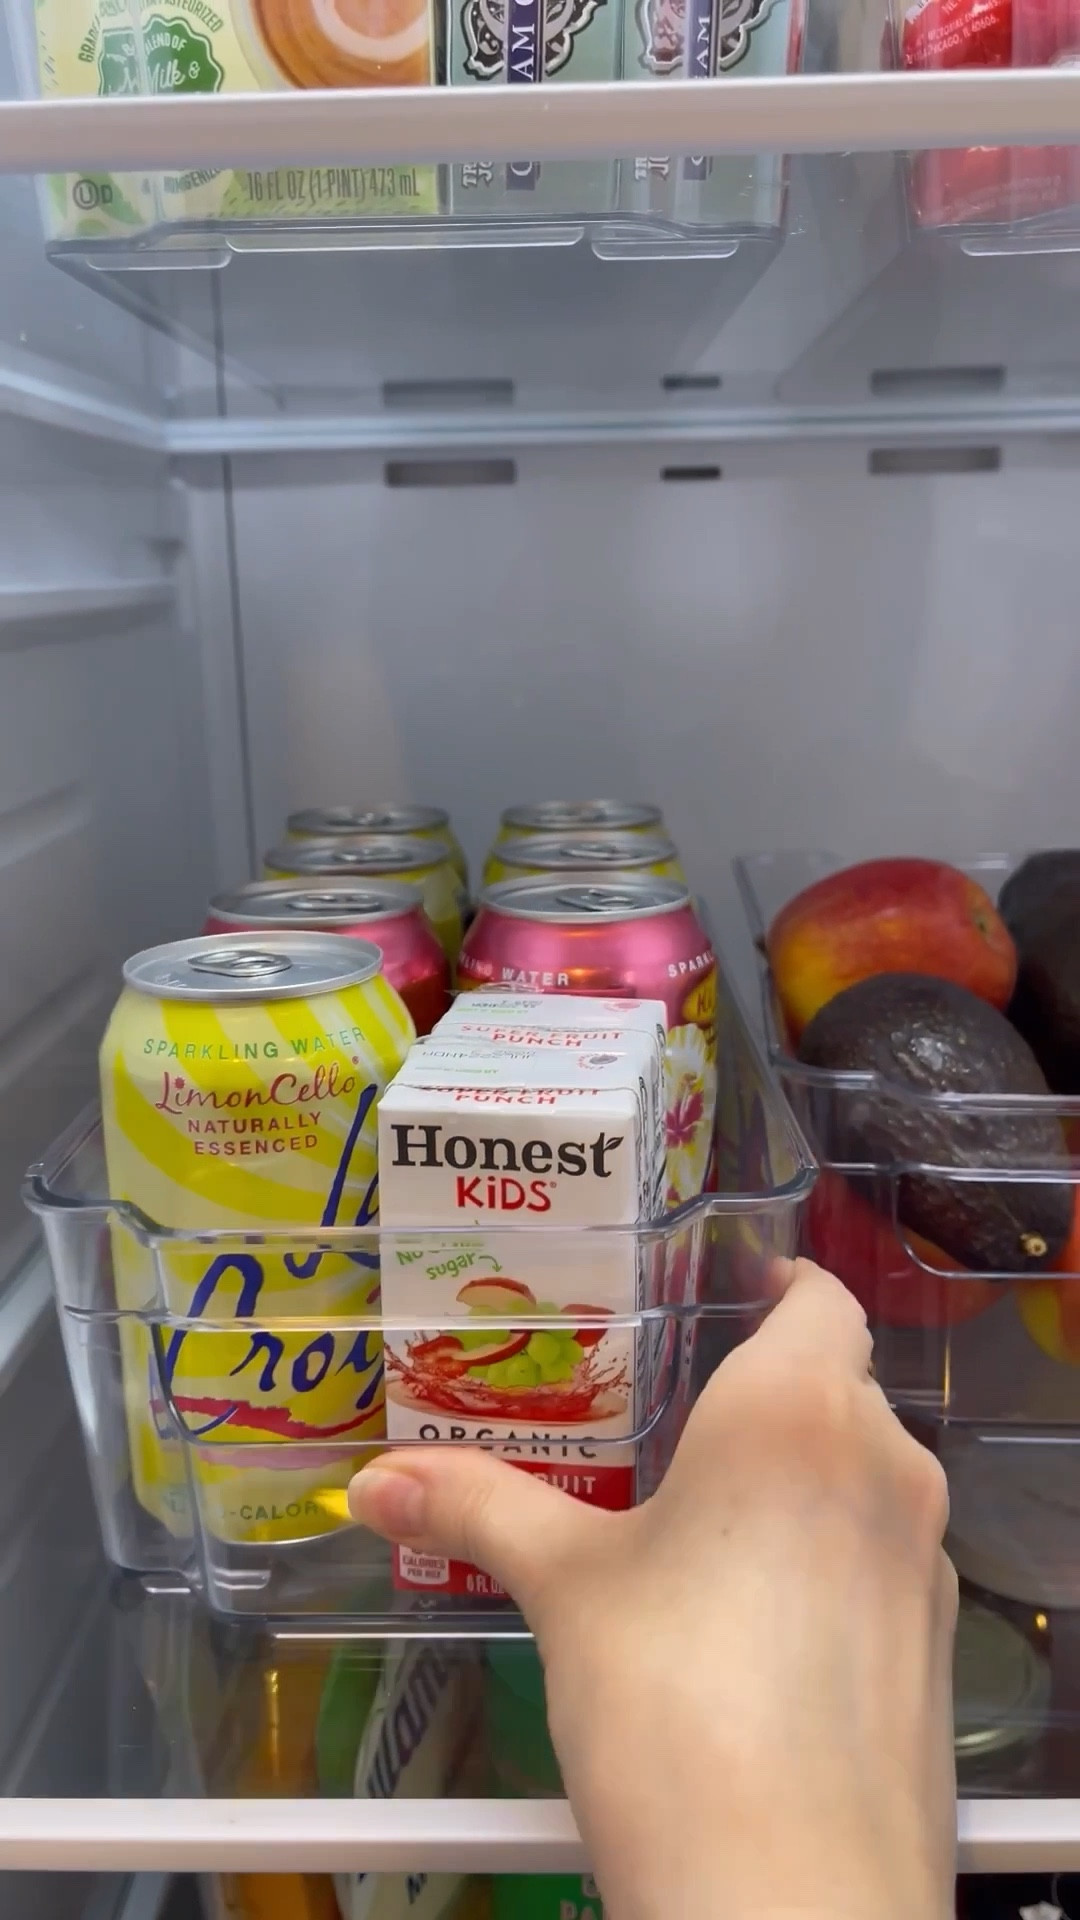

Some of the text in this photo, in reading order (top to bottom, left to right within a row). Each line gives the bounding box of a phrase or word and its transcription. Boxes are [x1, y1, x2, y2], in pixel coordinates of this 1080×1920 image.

[171, 35, 187, 51] OF
[267, 171, 284, 201] FL
[286, 169, 306, 201] OZ
[368, 167, 396, 198] 473
[399, 167, 421, 197] mL
[501, 966, 569, 987] WATER
[143, 1026, 365, 1060] SPARKLING WATER
[492, 1033, 583, 1048] PUNCH
[154, 1063, 356, 1115] LimonCello
[454, 1094, 557, 1106] PUNCH
[188, 1112, 322, 1135] NATURALLY
[193, 1135, 318, 1157] ESSENCED
[390, 1124, 624, 1178] Honest
[425, 1251, 476, 1281] sugar
